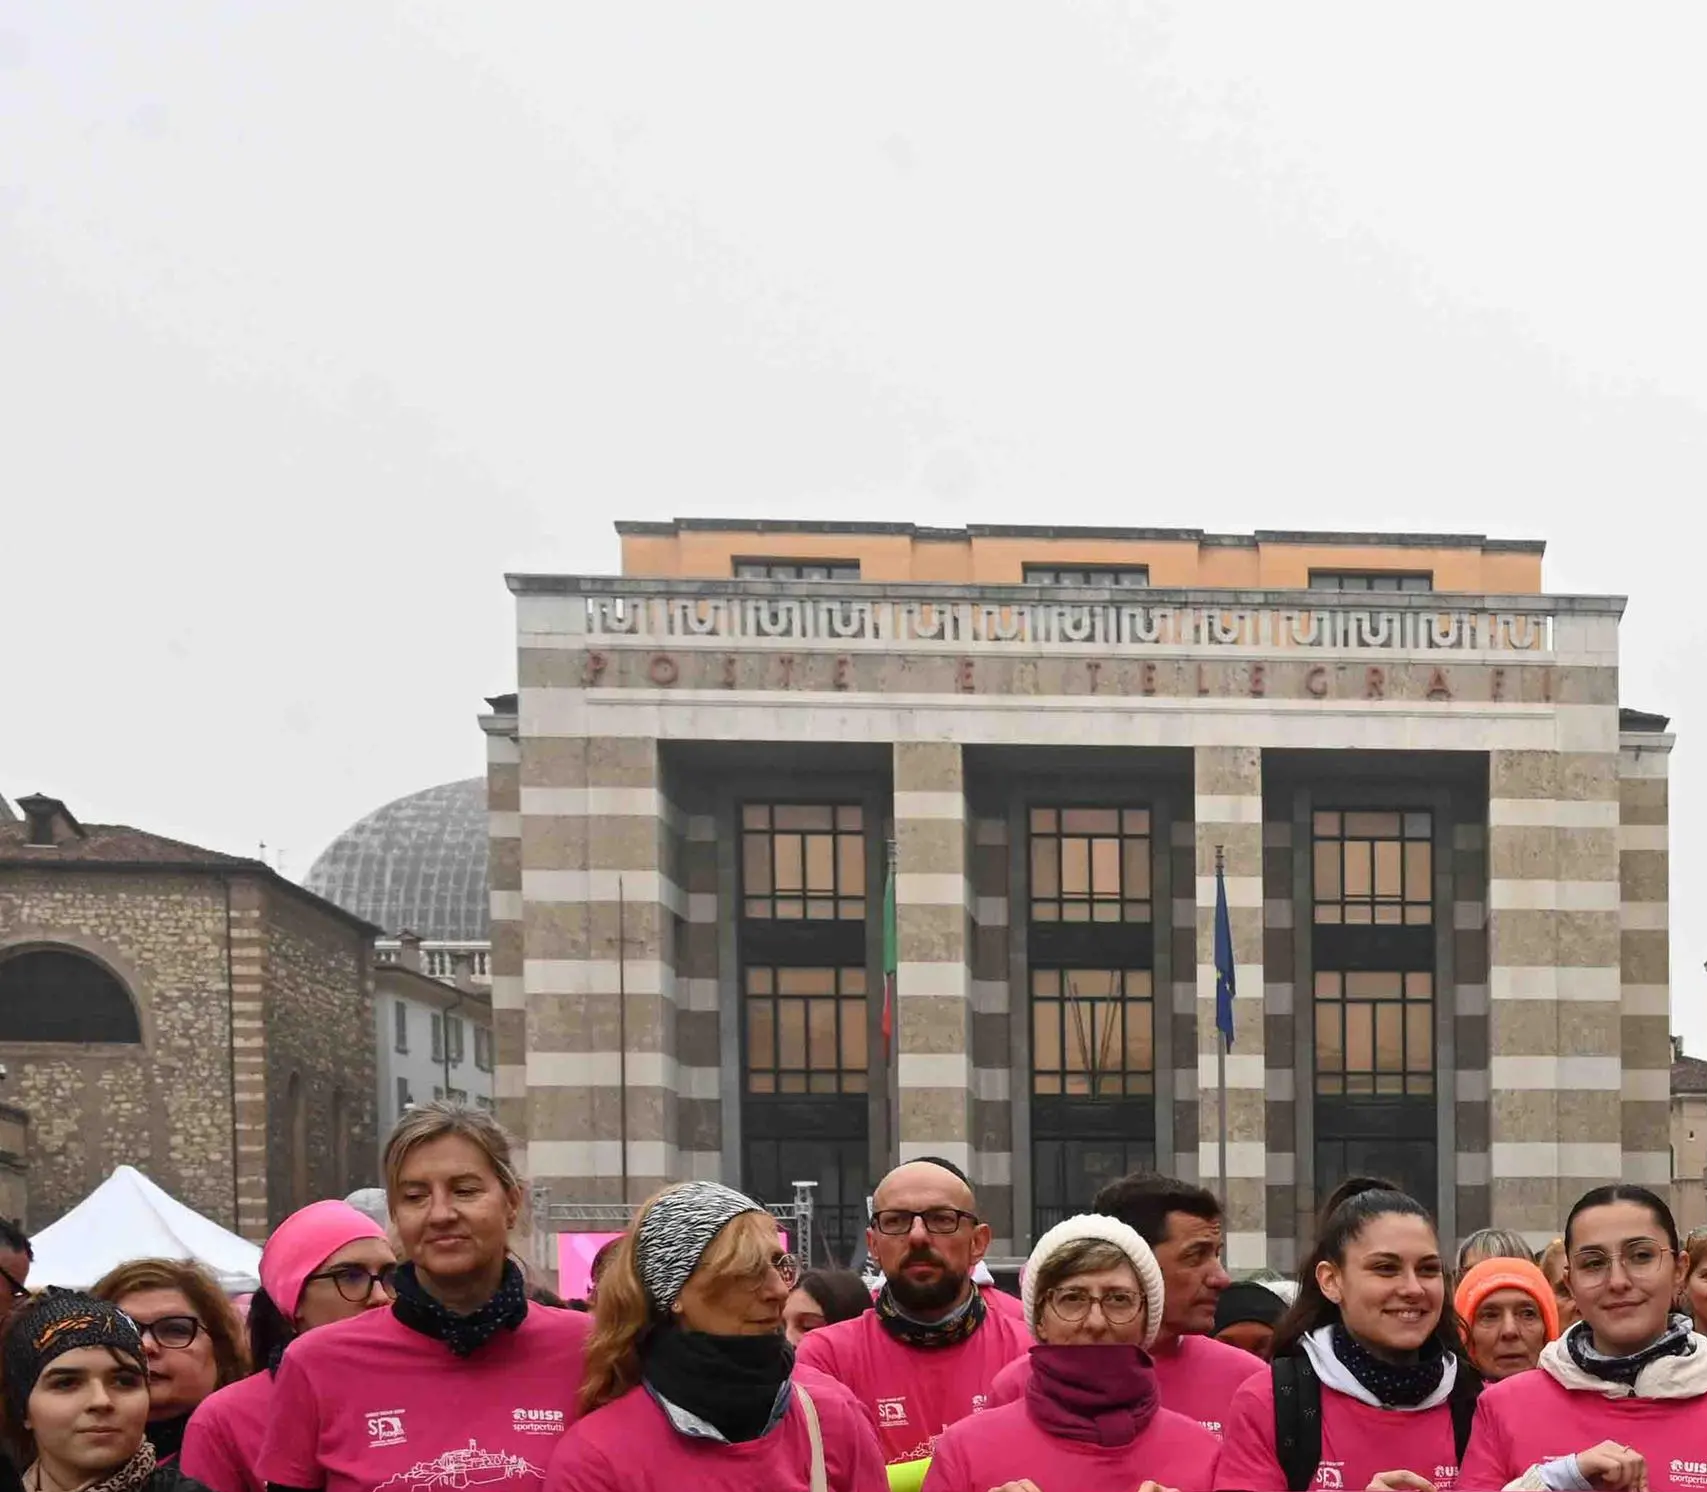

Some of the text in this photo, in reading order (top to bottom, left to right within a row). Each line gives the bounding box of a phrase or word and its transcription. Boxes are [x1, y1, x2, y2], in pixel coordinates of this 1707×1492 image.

[583, 653, 1551, 702] POSTE E TELEGRAFI
[528, 1410, 563, 1421] UISP
[513, 1422, 564, 1433] sportpertutti
